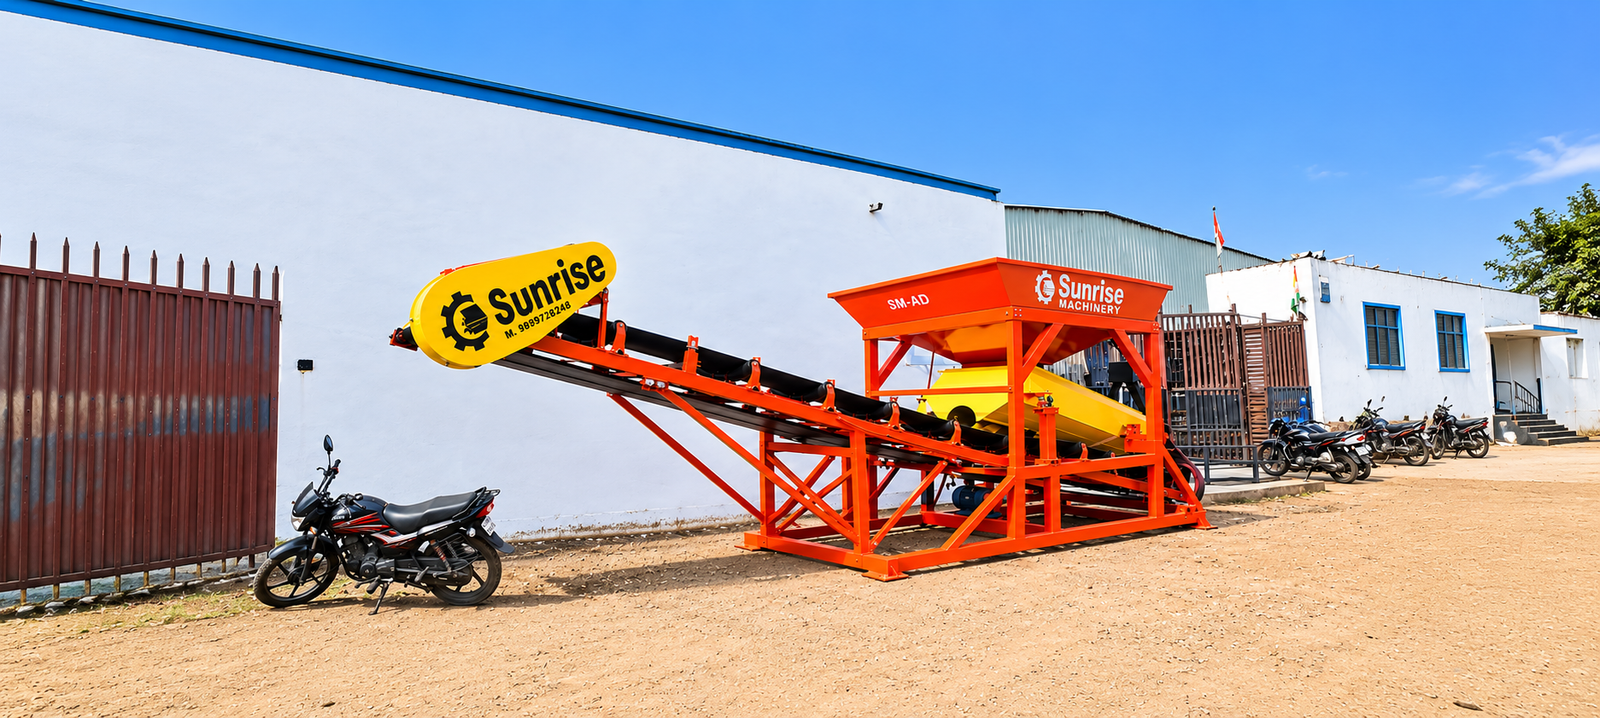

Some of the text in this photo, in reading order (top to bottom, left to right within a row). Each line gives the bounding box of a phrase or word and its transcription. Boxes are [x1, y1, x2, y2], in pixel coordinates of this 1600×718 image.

[488, 255, 606, 325] Sunrise
[1059, 274, 1124, 304] Sunrise
[887, 294, 930, 310] SM-AD
[1059, 299, 1121, 315] MACHINERY
[504, 329, 517, 339] M.
